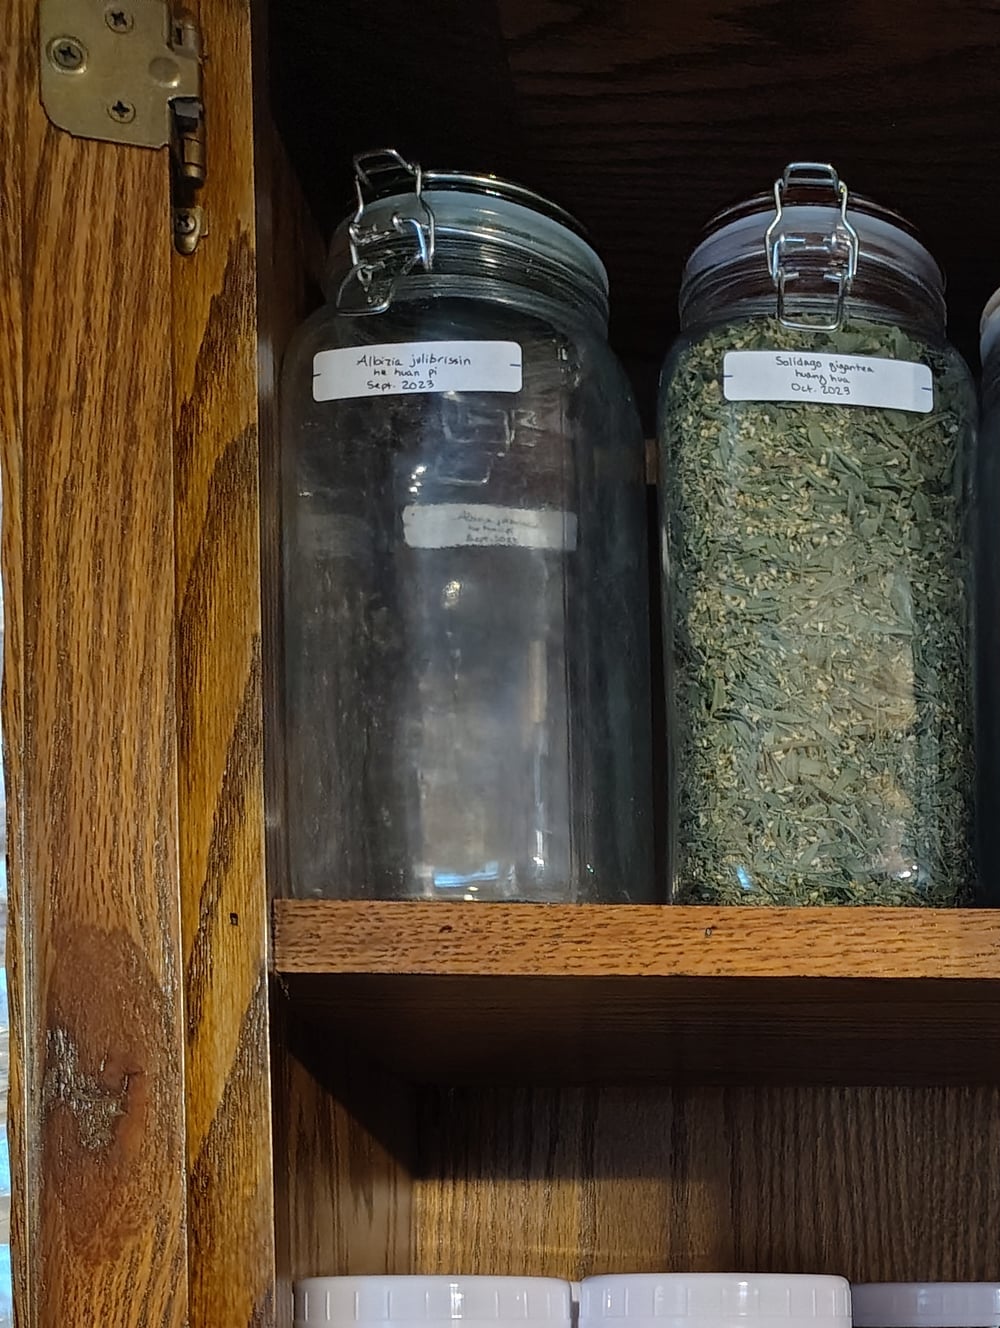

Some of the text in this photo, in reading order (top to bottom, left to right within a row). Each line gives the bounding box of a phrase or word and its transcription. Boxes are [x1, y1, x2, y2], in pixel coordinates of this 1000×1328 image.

[356, 354, 403, 367] Albizia
[775, 356, 875, 374] Solidago gigantea
[394, 368, 419, 377] huan
[428, 367, 438, 378] pi
[795, 370, 850, 385] huang hua
[367, 380, 434, 392] Sept. 2023
[791, 383, 817, 393] Oct.
